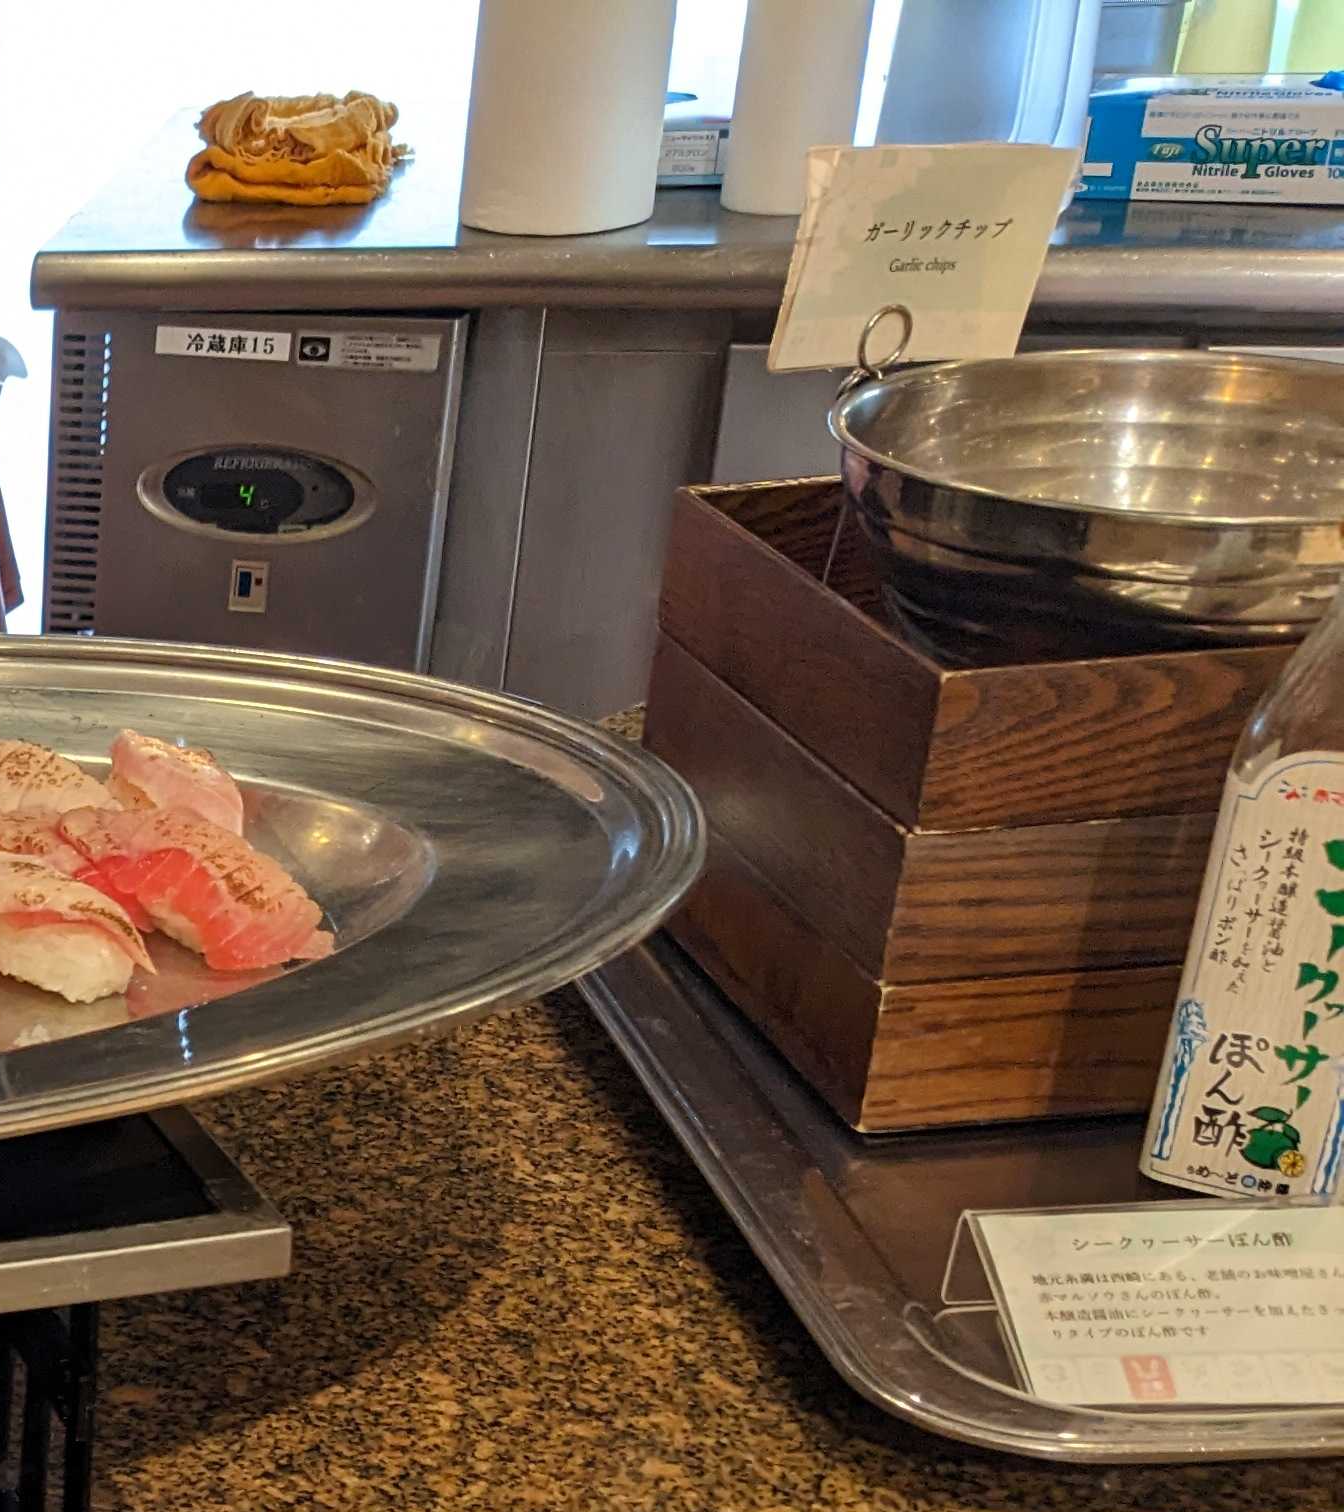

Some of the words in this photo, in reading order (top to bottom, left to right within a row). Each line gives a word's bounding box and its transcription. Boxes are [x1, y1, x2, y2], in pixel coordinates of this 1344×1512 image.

[1192, 124, 1330, 179] Super
[1192, 165, 1239, 178] Nitrile
[1264, 165, 1315, 178] Gloves
[864, 218, 1014, 242] ガーリックチップ
[889, 257, 923, 272] Garlic
[925, 256, 957, 274] chips
[186, 333, 275, 355] 冷蔵庫15
[239, 484, 255, 506] 4
[1192, 1033, 1270, 1158] ぽん酢
